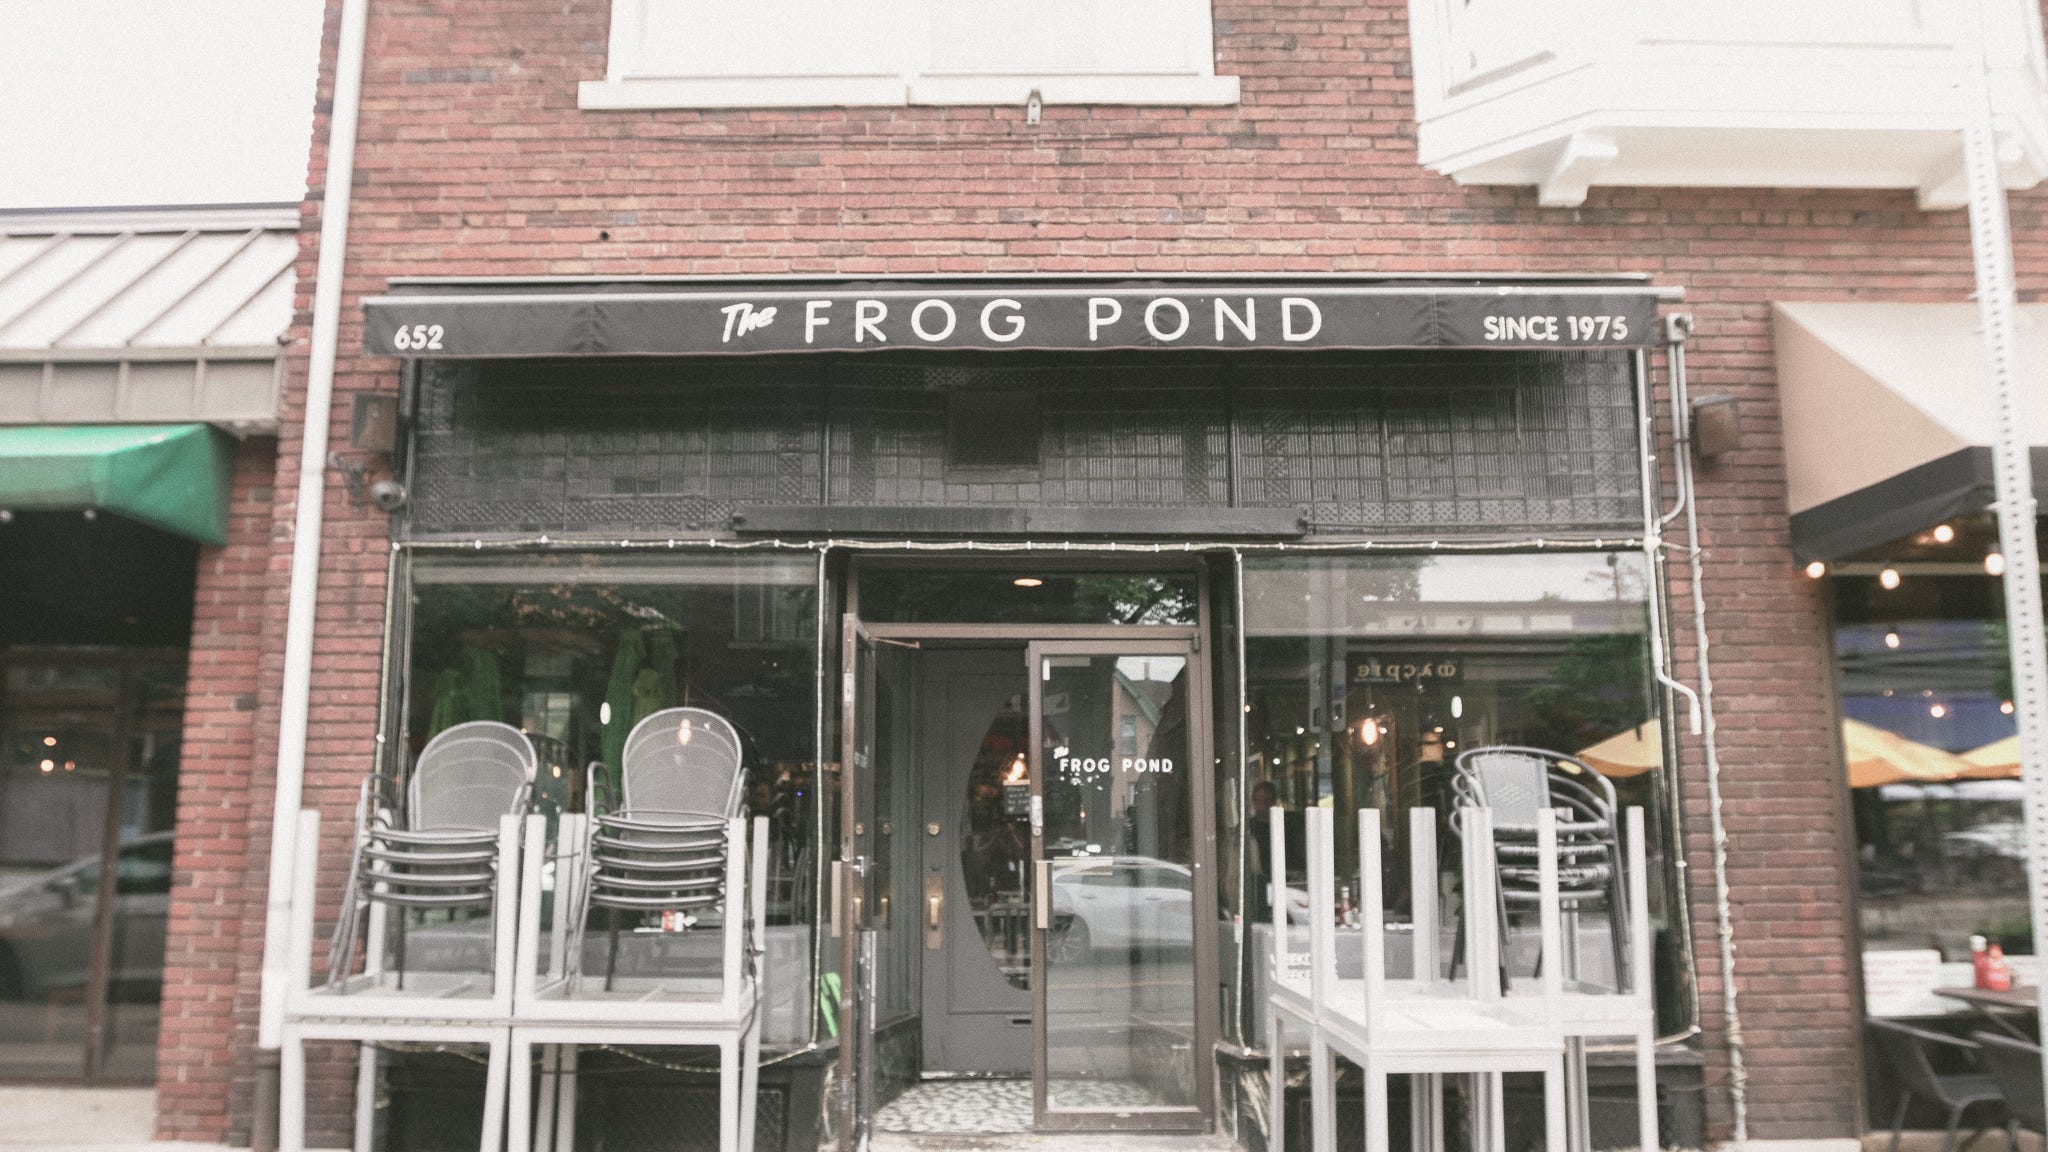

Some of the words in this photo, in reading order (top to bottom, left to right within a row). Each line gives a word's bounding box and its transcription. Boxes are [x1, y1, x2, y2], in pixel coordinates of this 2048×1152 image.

[720, 302, 778, 343] The
[804, 298, 1026, 344] FROG
[1088, 297, 1323, 343] POND
[1483, 315, 1560, 342] SINCE
[1566, 315, 1629, 342] 1975
[393, 324, 445, 351] 652
[1059, 757, 1111, 773] FROG
[1121, 757, 1173, 773] POND
